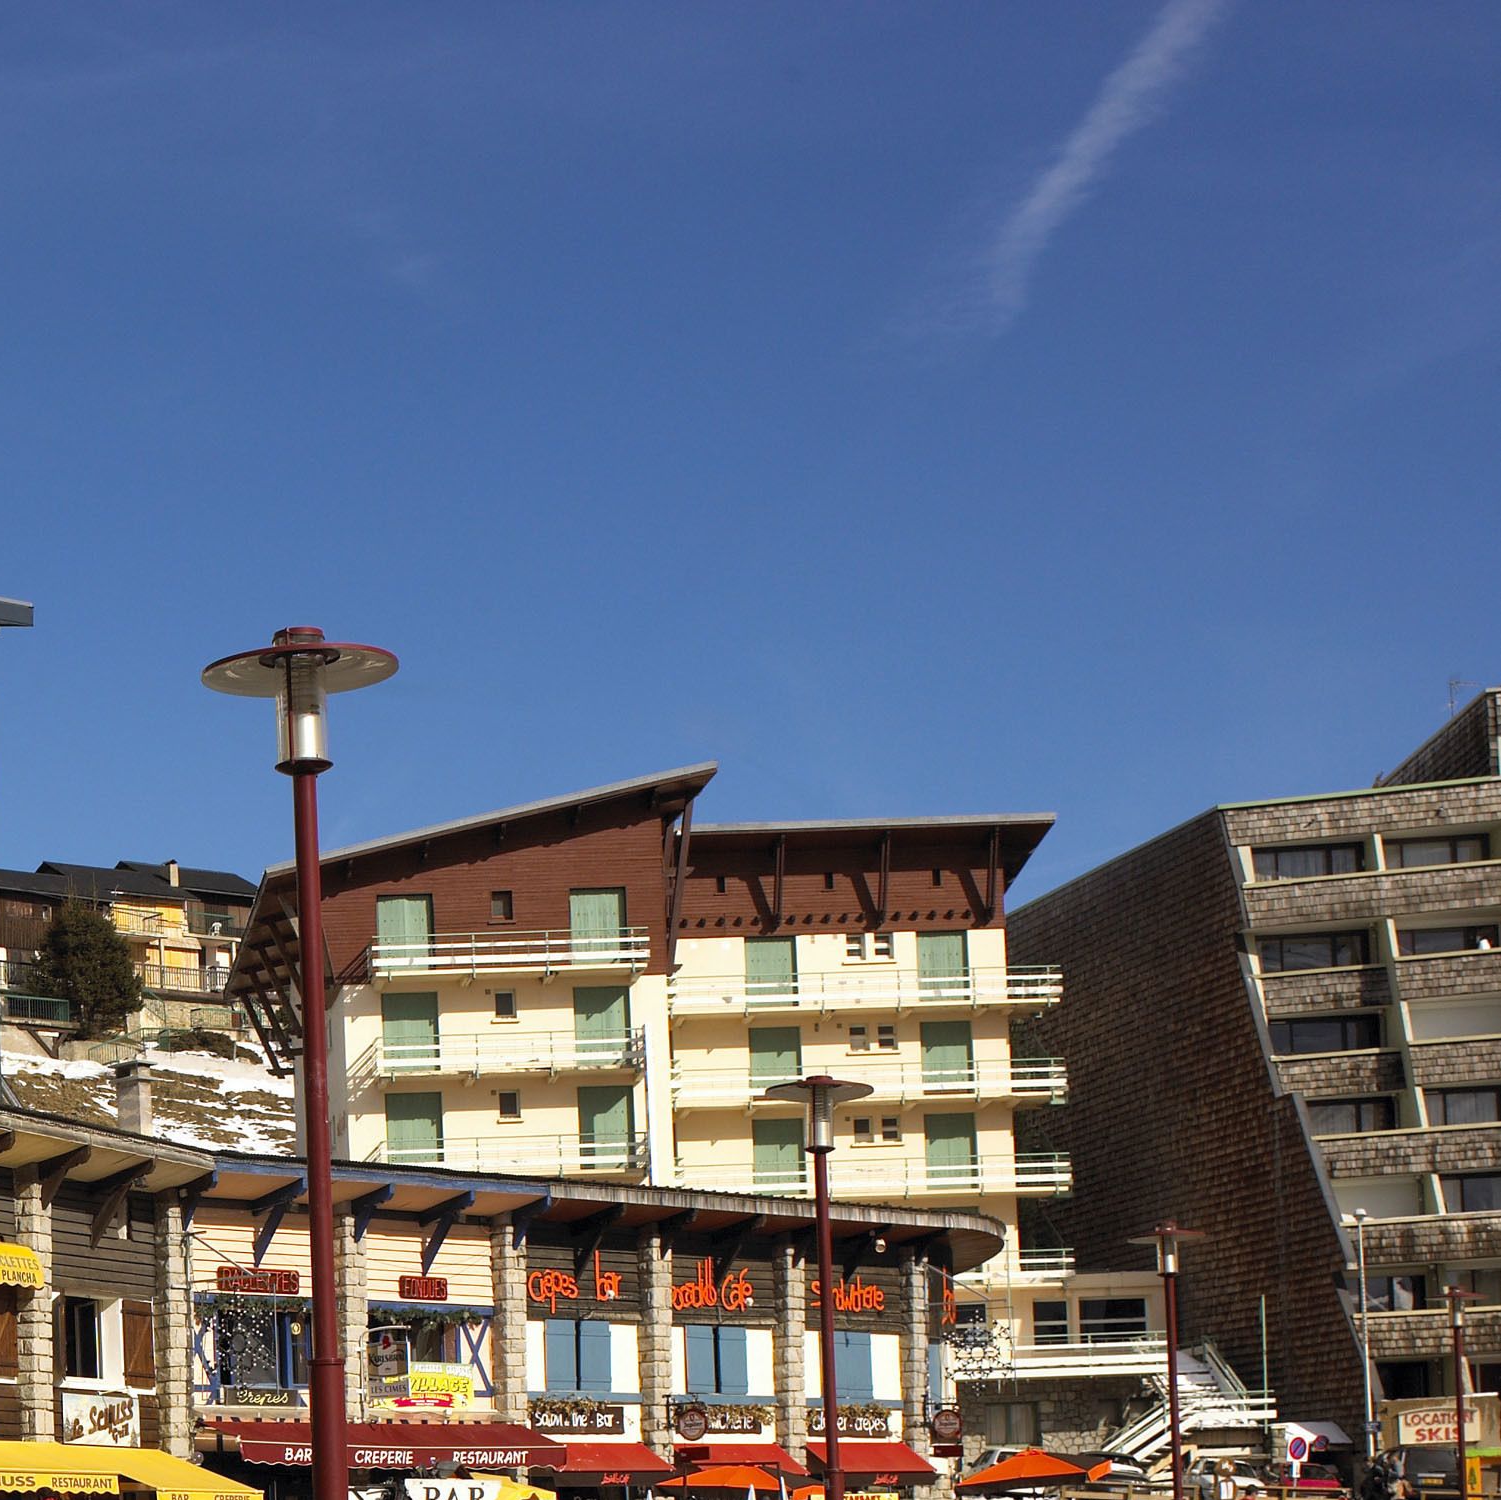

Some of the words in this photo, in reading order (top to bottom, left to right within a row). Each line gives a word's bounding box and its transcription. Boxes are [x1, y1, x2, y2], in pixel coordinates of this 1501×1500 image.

[1, 1270, 37, 1284] PLANCHA
[594, 1249, 623, 1302] bar
[404, 1277, 447, 1299] FONDUES
[370, 1384, 383, 1395] LES
[385, 1383, 407, 1394] CIMES
[284, 1447, 313, 1462] BAR
[354, 1450, 414, 1465] CREPERIE
[452, 1450, 530, 1465] RESTAURANT
[51, 1477, 113, 1489] RESTAURANT
